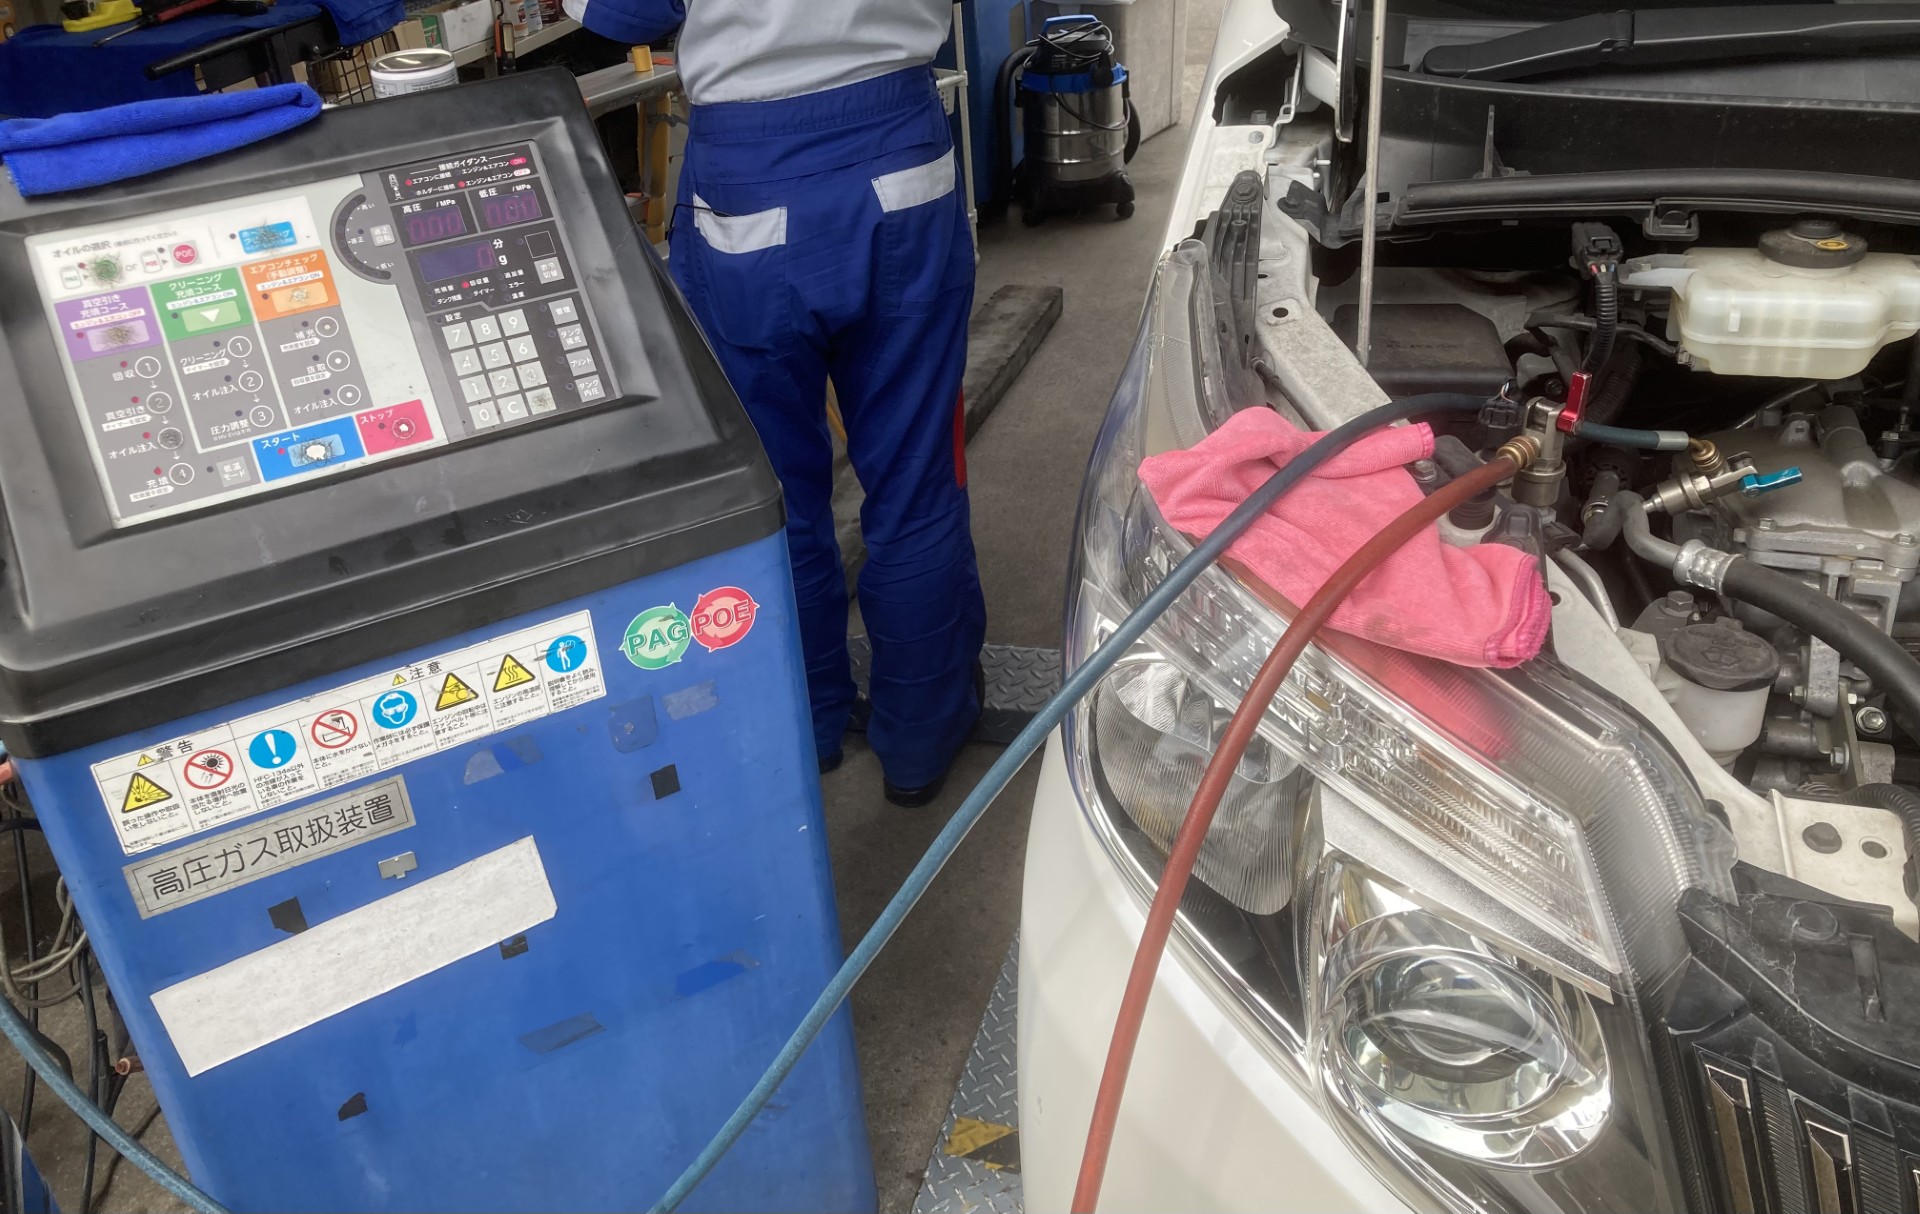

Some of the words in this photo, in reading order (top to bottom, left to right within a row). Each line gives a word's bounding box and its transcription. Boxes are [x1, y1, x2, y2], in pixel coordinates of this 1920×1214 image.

[438, 156, 488, 172] 接続ガイダンス
[412, 172, 452, 184] エアコンに接続
[479, 187, 498, 199] 低圧
[402, 202, 422, 214] 高圧
[493, 238, 503, 249] 分
[175, 248, 194, 259] POE
[477, 246, 494, 267] 0
[499, 254, 508, 265] g
[125, 262, 138, 271] or
[250, 253, 318, 274] エアコンチェック
[168, 273, 222, 291] クリーニング
[508, 281, 524, 289] エラー
[175, 283, 222, 300] 充填コース
[473, 287, 495, 296] タイマー
[81, 294, 120, 309] 真空引き
[445, 312, 462, 322] 設定
[508, 316, 518, 329] 9
[295, 328, 316, 341] 補充
[480, 323, 491, 335] 8
[561, 328, 580, 338] タンク
[452, 329, 461, 342] 7
[235, 342, 243, 351] 1
[519, 342, 528, 354] 6
[180, 348, 227, 366] クリーニング
[491, 349, 499, 361] 5
[144, 362, 152, 373] 1
[462, 355, 471, 368] 4
[570, 357, 592, 368] プリント
[112, 370, 135, 382] 回収
[247, 377, 256, 387] 2
[497, 375, 507, 388] 2
[471, 382, 479, 394] 1
[579, 379, 599, 390] タンク
[192, 384, 239, 400] オイル注入
[583, 388, 600, 397] 内圧
[154, 398, 165, 409] 2
[293, 398, 338, 415] オイル注入
[507, 401, 519, 413] C
[105, 405, 145, 422] 真空引き
[257, 411, 266, 422] 3
[360, 408, 395, 425] ストップ
[480, 409, 490, 421] 0
[210, 419, 250, 436] 圧力調整
[261, 433, 300, 449] スタート
[108, 441, 158, 459] オイル注入
[223, 470, 246, 482] モード
[146, 477, 170, 489] 充填
[693, 599, 753, 636] POE
[626, 620, 690, 656] PAG
[410, 661, 441, 680] 注意
[156, 740, 194, 758] 警告
[314, 760, 332, 770] こと。
[147, 794, 395, 900] 高圧ガス取扱装置
